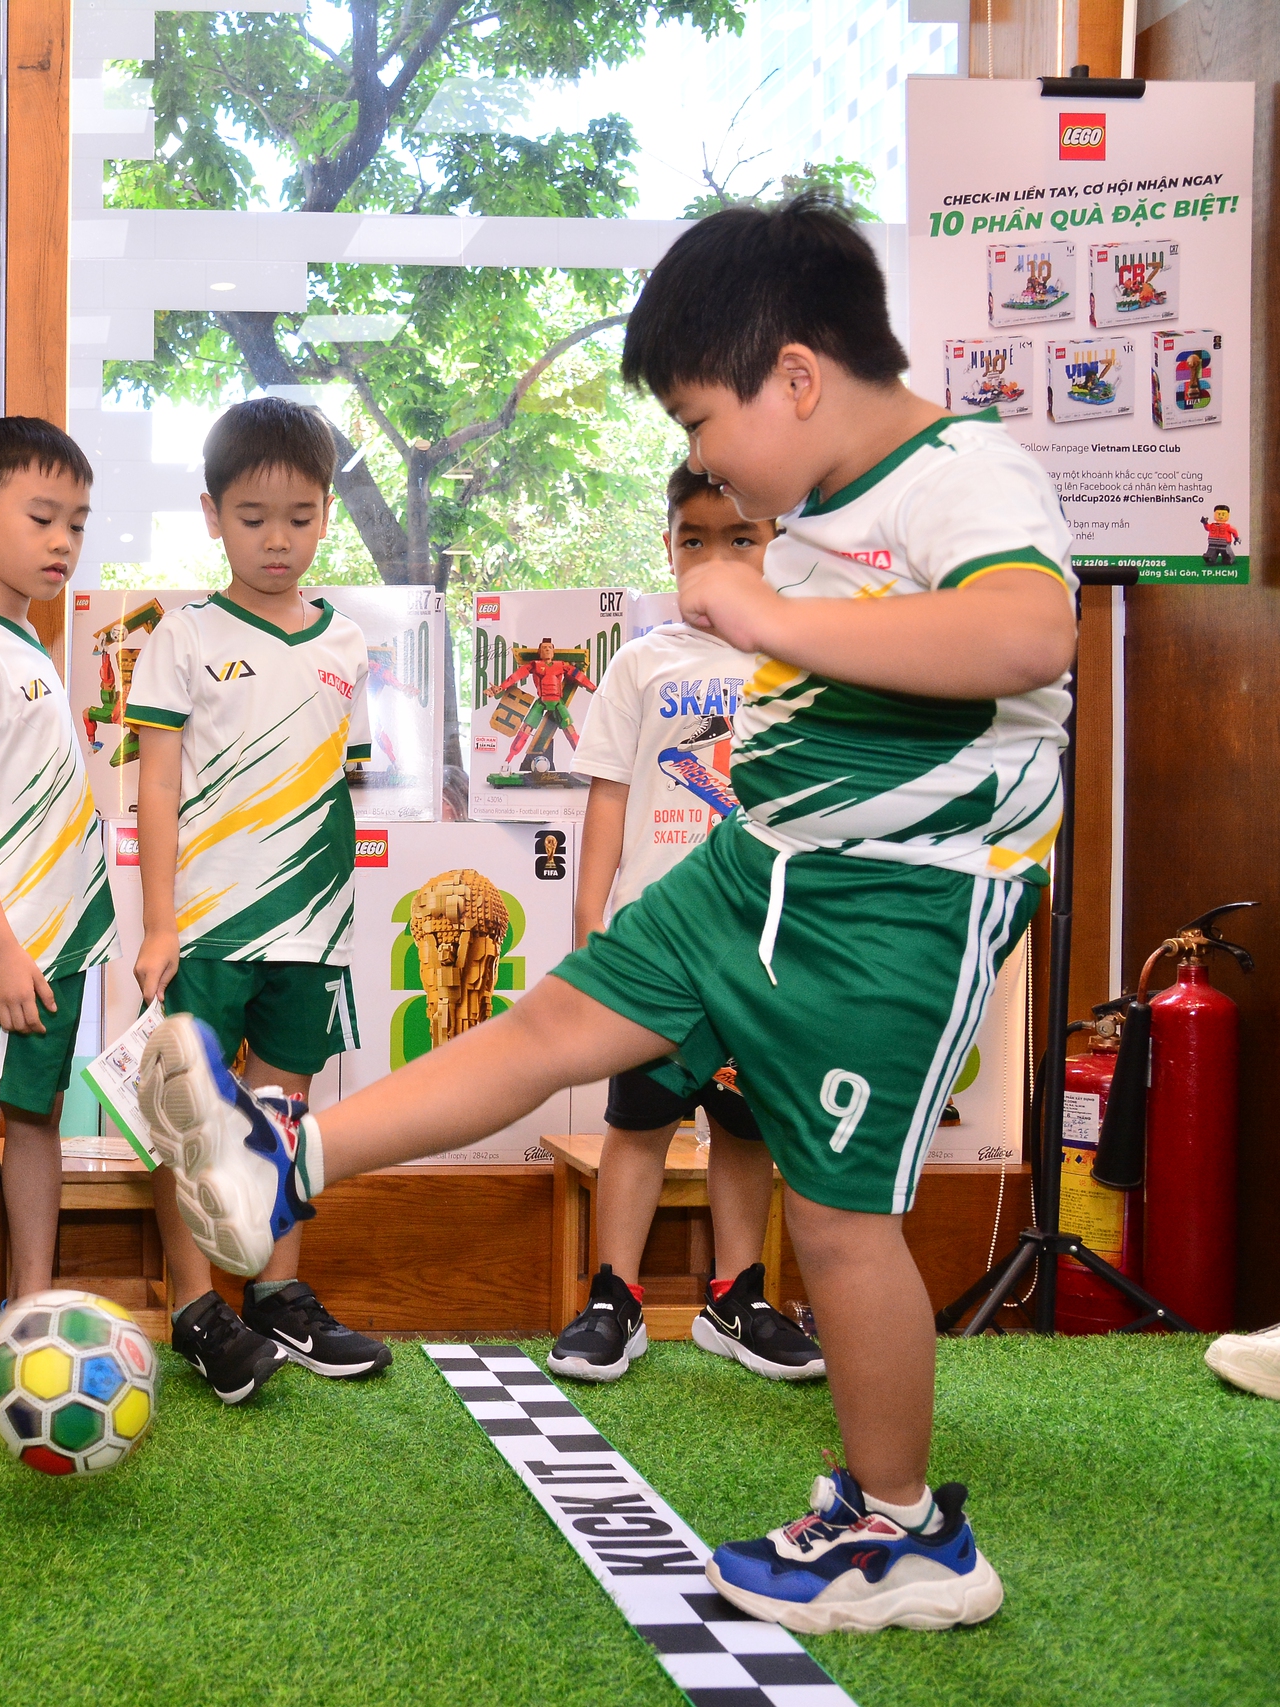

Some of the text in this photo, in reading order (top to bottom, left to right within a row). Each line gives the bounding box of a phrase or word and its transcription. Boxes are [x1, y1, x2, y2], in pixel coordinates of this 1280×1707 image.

[1062, 128, 1103, 146] LEGO
[943, 191, 1011, 206] CHECK-IN
[1049, 186, 1079, 198] TAY,
[1083, 182, 1104, 195] CƠ
[1106, 179, 1133, 196] HỘI
[1136, 176, 1179, 192] NHẬN
[1182, 173, 1223, 187] NGAY
[929, 193, 1239, 237] 10 PHẦN QUÀ ĐẶC BIỆT!
[1051, 443, 1089, 454] Fanpage
[1091, 443, 1130, 453] Vietnam
[1132, 444, 1157, 453] LEGO
[1159, 443, 1181, 453] Club
[1062, 471, 1080, 480] một
[1115, 468, 1135, 480] khắc
[1137, 472, 1153, 481] cực
[1180, 471, 1203, 481] cùng
[1064, 482, 1078, 491] lên
[1079, 482, 1121, 491] Facebook
[1122, 482, 1133, 491] cá
[1135, 482, 1156, 491] nhân
[1158, 482, 1177, 491] kèm
[1178, 482, 1213, 493] hashtag
[1123, 494, 1204, 503] #ChienBinhSanCo
[1073, 518, 1130, 531] bạn may mắn
[1076, 532, 1095, 540] nhé!
[1083, 559, 1109, 567] 22/05
[1118, 559, 1167, 567] 01/06/2026
[1139, 569, 1238, 578] ường Sài Gòn, TP.HCM)
[478, 602, 499, 613] LEGO
[600, 592, 624, 612] CR7
[659, 677, 744, 719] SKAT
[519, 807, 539, 815] Football
[563, 807, 575, 815] 854
[654, 809, 703, 823] BORN TO
[654, 831, 688, 844] SKATE
[356, 841, 385, 855] LEGO
[820, 1067, 871, 1154] 9
[447, 1151, 499, 1162] Trophy 2842 pcs
[928, 1151, 943, 1159] 2842
[522, 1459, 706, 1577] KICK IT
